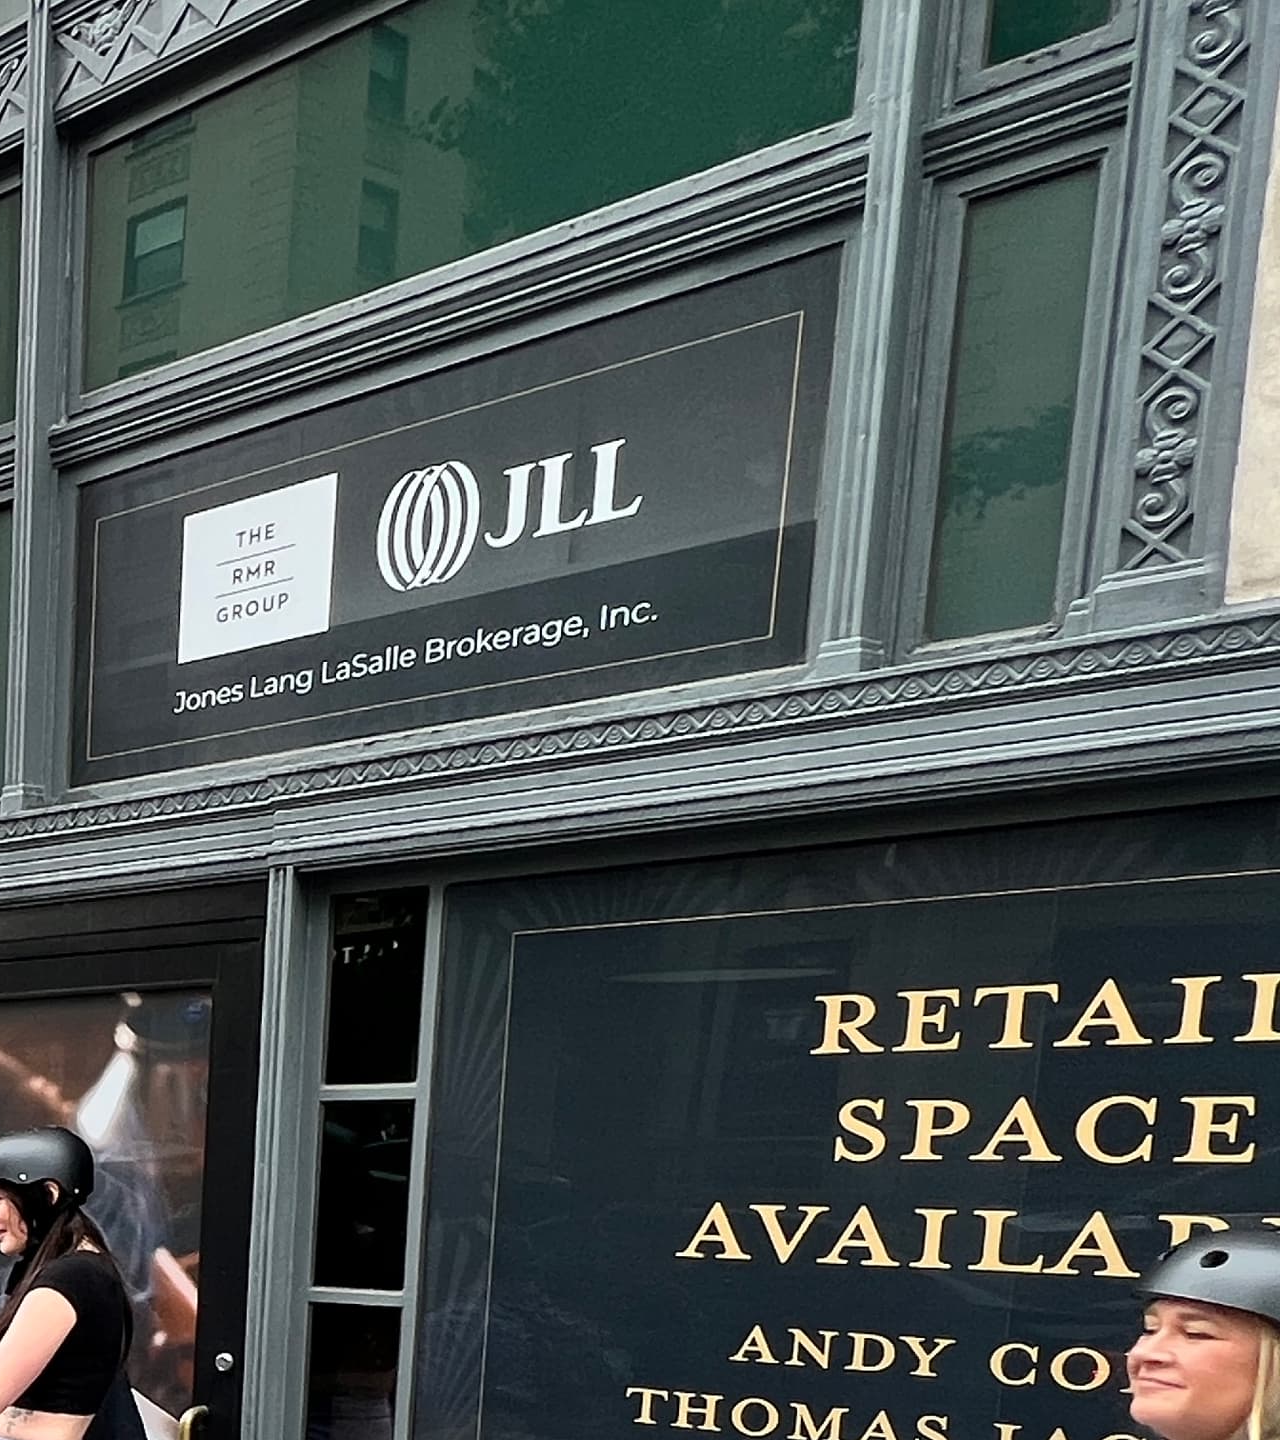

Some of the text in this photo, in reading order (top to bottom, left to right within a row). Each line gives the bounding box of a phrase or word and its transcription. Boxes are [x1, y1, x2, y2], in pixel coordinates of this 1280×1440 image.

[484, 437, 643, 549] JLL
[235, 522, 275, 548] THE
[216, 592, 289, 623] GROUP
[232, 560, 275, 585] RMR
[173, 601, 659, 714] Jones Lang LaSalle Brokerage, Inc.
[833, 1094, 1256, 1164] SPACE
[729, 1324, 1132, 1394] ANDY CO
